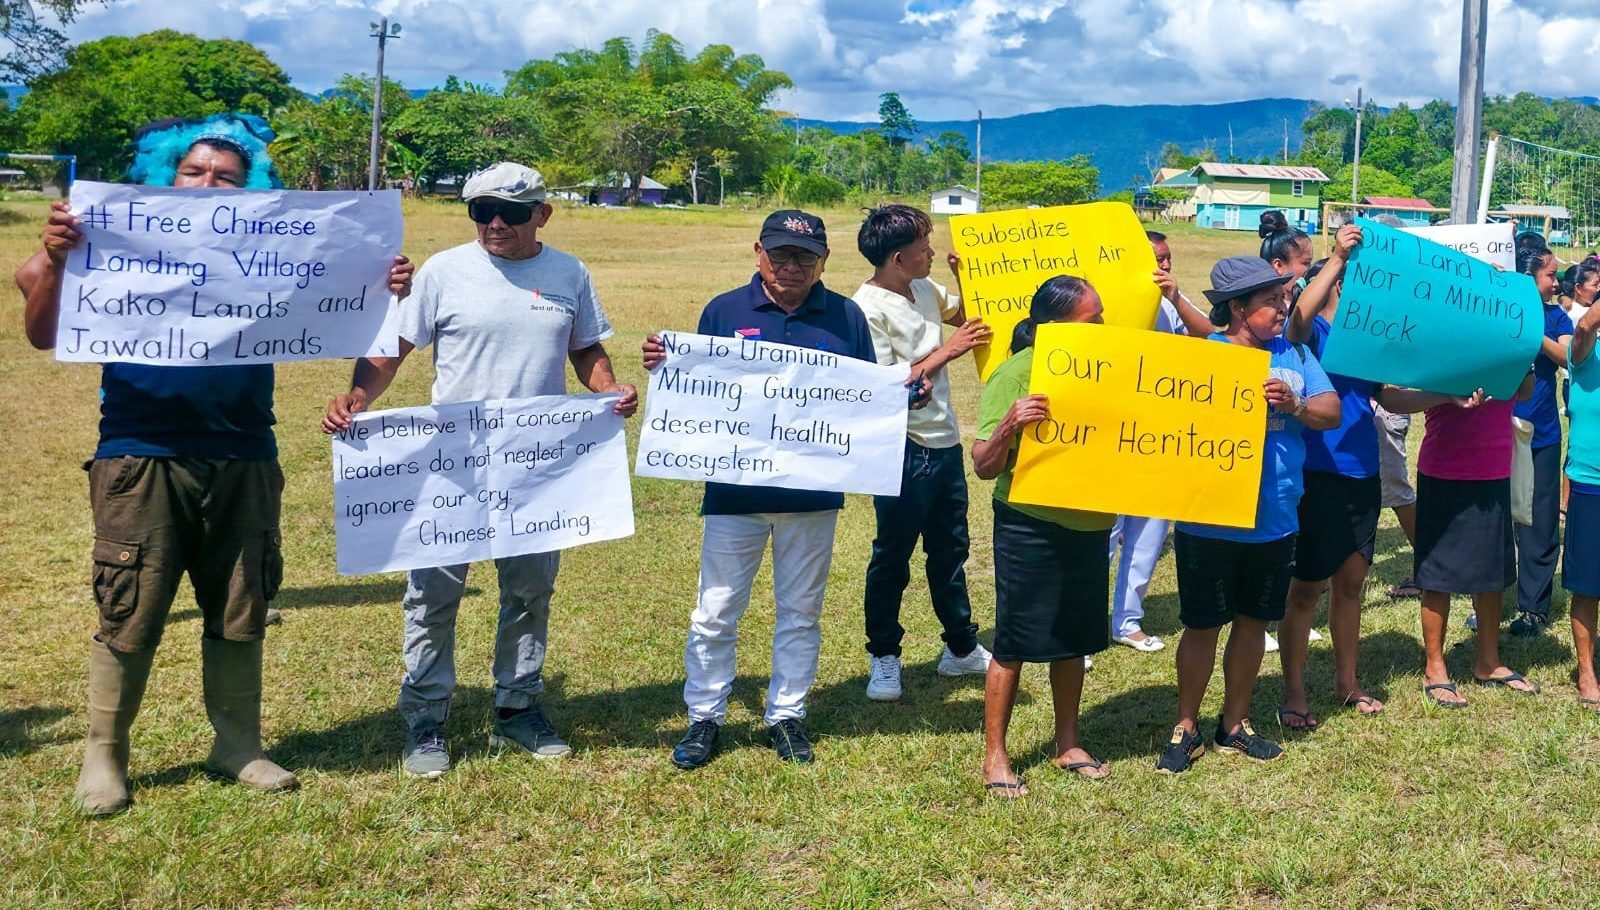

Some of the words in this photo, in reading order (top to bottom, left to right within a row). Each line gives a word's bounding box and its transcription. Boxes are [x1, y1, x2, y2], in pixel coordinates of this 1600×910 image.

[128, 202, 192, 234] Free
[212, 206, 316, 235] Chinese
[962, 219, 1070, 248] Subsidize
[967, 248, 1079, 281] Hinterland
[1098, 245, 1127, 264] Air
[1361, 226, 1402, 255] Our
[1417, 236, 1472, 280] Land
[1488, 241, 1513, 254] are
[86, 243, 207, 287] Landing
[232, 249, 327, 289] Village
[77, 285, 167, 317] Kako
[191, 291, 290, 319] Lands
[318, 286, 367, 313] and
[971, 285, 1039, 316] trave
[1353, 262, 1401, 292] NOT
[1413, 280, 1432, 301] a
[1445, 284, 1524, 339] Mining
[1343, 300, 1417, 343] Block
[66, 327, 212, 361] Jawalla
[234, 328, 322, 359] Lands
[661, 333, 691, 356] No
[706, 336, 729, 358] to
[740, 339, 839, 369] Uranium
[657, 367, 743, 412] Mining
[763, 375, 872, 407] Guyanese
[1047, 348, 1112, 383] Our
[1136, 355, 1214, 405] Land
[1232, 380, 1255, 412] is
[339, 420, 369, 441] We
[382, 416, 457, 440] believe
[469, 406, 505, 431] that
[516, 409, 594, 429] concern
[651, 408, 751, 436] deserve
[770, 413, 851, 456] healthy
[339, 454, 420, 481] leaders
[429, 448, 455, 473] do
[463, 446, 491, 468] not
[503, 438, 565, 471] neglect
[575, 440, 597, 456] or
[646, 444, 780, 477] ecosystem.
[1035, 418, 1097, 446] Our
[1118, 420, 1254, 472] Heritage
[346, 495, 415, 527] ignore
[432, 493, 467, 510] our
[477, 488, 513, 512] cry.
[418, 520, 497, 547] Chinese
[511, 511, 591, 537] Landing
